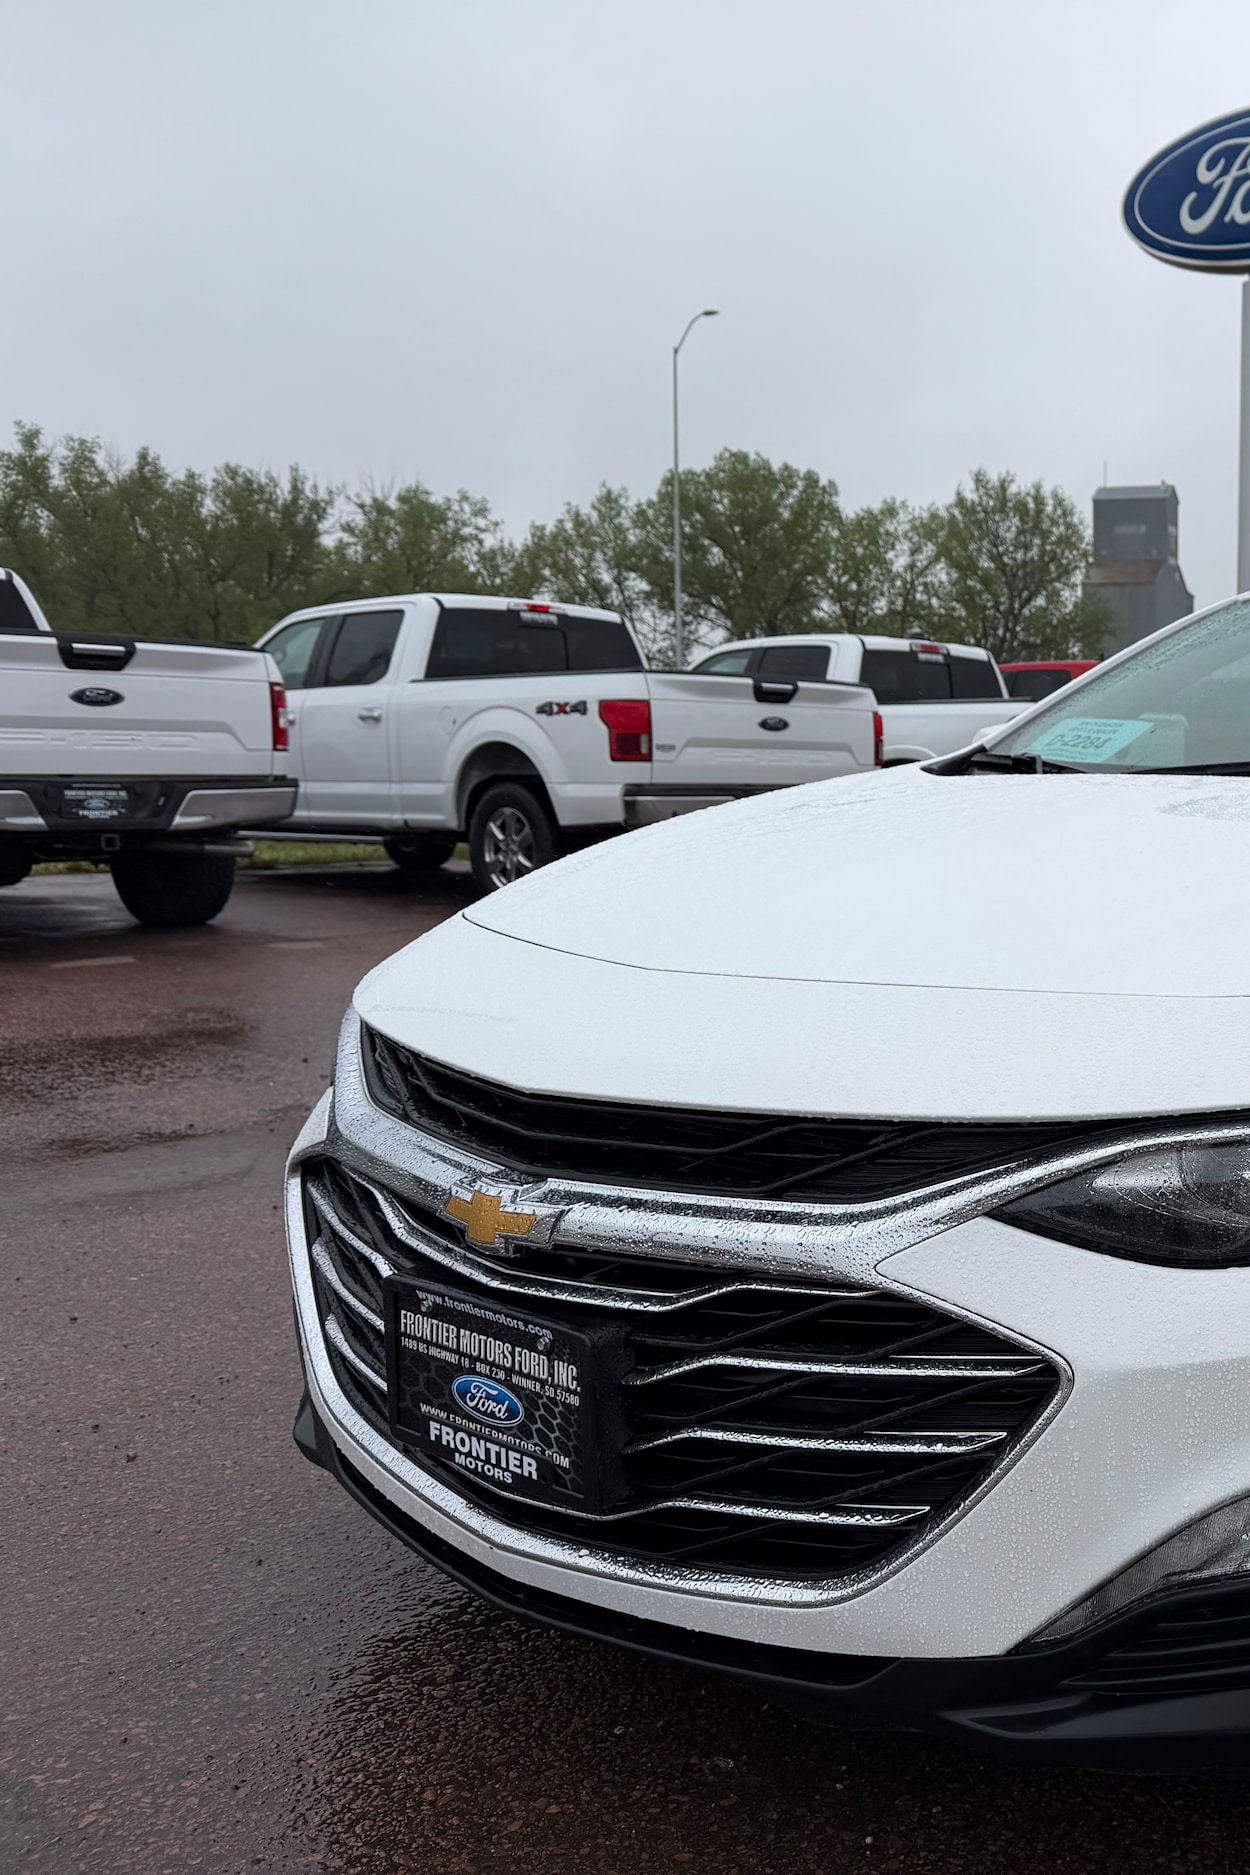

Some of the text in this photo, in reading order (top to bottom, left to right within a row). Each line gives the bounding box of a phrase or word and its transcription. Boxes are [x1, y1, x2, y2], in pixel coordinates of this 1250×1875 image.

[400, 1309, 581, 1392] FRONTIER MOTORS FORD, INC.
[428, 1345, 460, 1364] HIGHWAY
[475, 1361, 491, 1376] BOX
[491, 1367, 506, 1380] 230
[556, 1389, 580, 1407] 57580
[466, 1381, 510, 1419] Ford
[420, 1402, 570, 1469] WWWFRONTIERMOTORSCOM
[428, 1420, 539, 1481] FRONTIER
[454, 1452, 513, 1484] MOTORS
